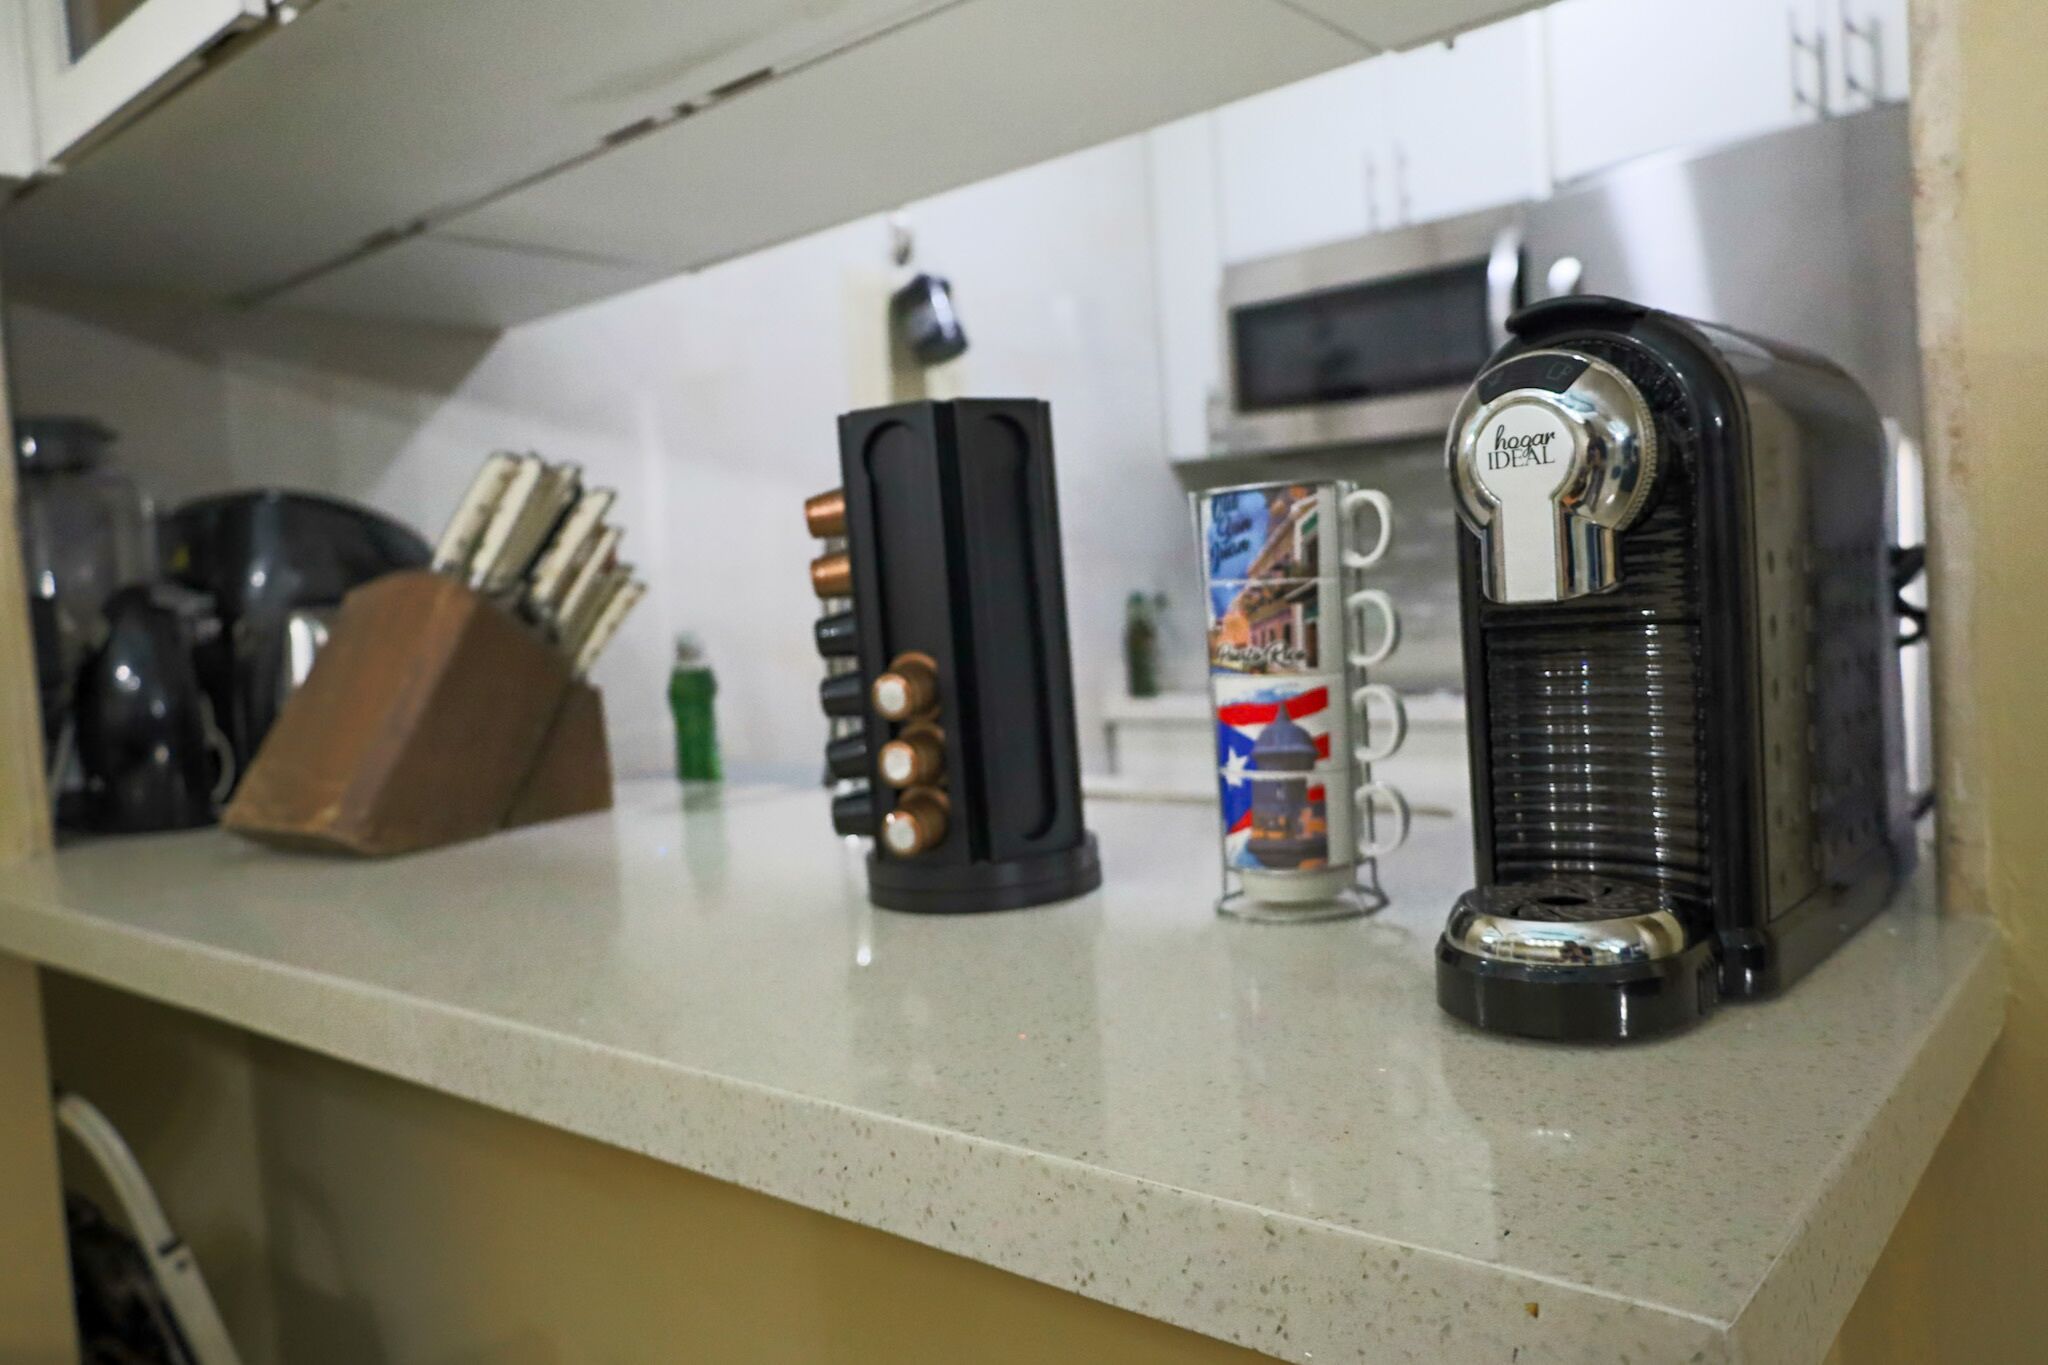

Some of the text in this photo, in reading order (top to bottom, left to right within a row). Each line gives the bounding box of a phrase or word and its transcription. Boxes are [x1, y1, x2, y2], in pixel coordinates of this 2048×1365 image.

[1495, 424, 1556, 457] hogar
[1488, 445, 1556, 470] IDEAL
[1210, 536, 1249, 572] Juan
[1263, 639, 1307, 666] Rico
